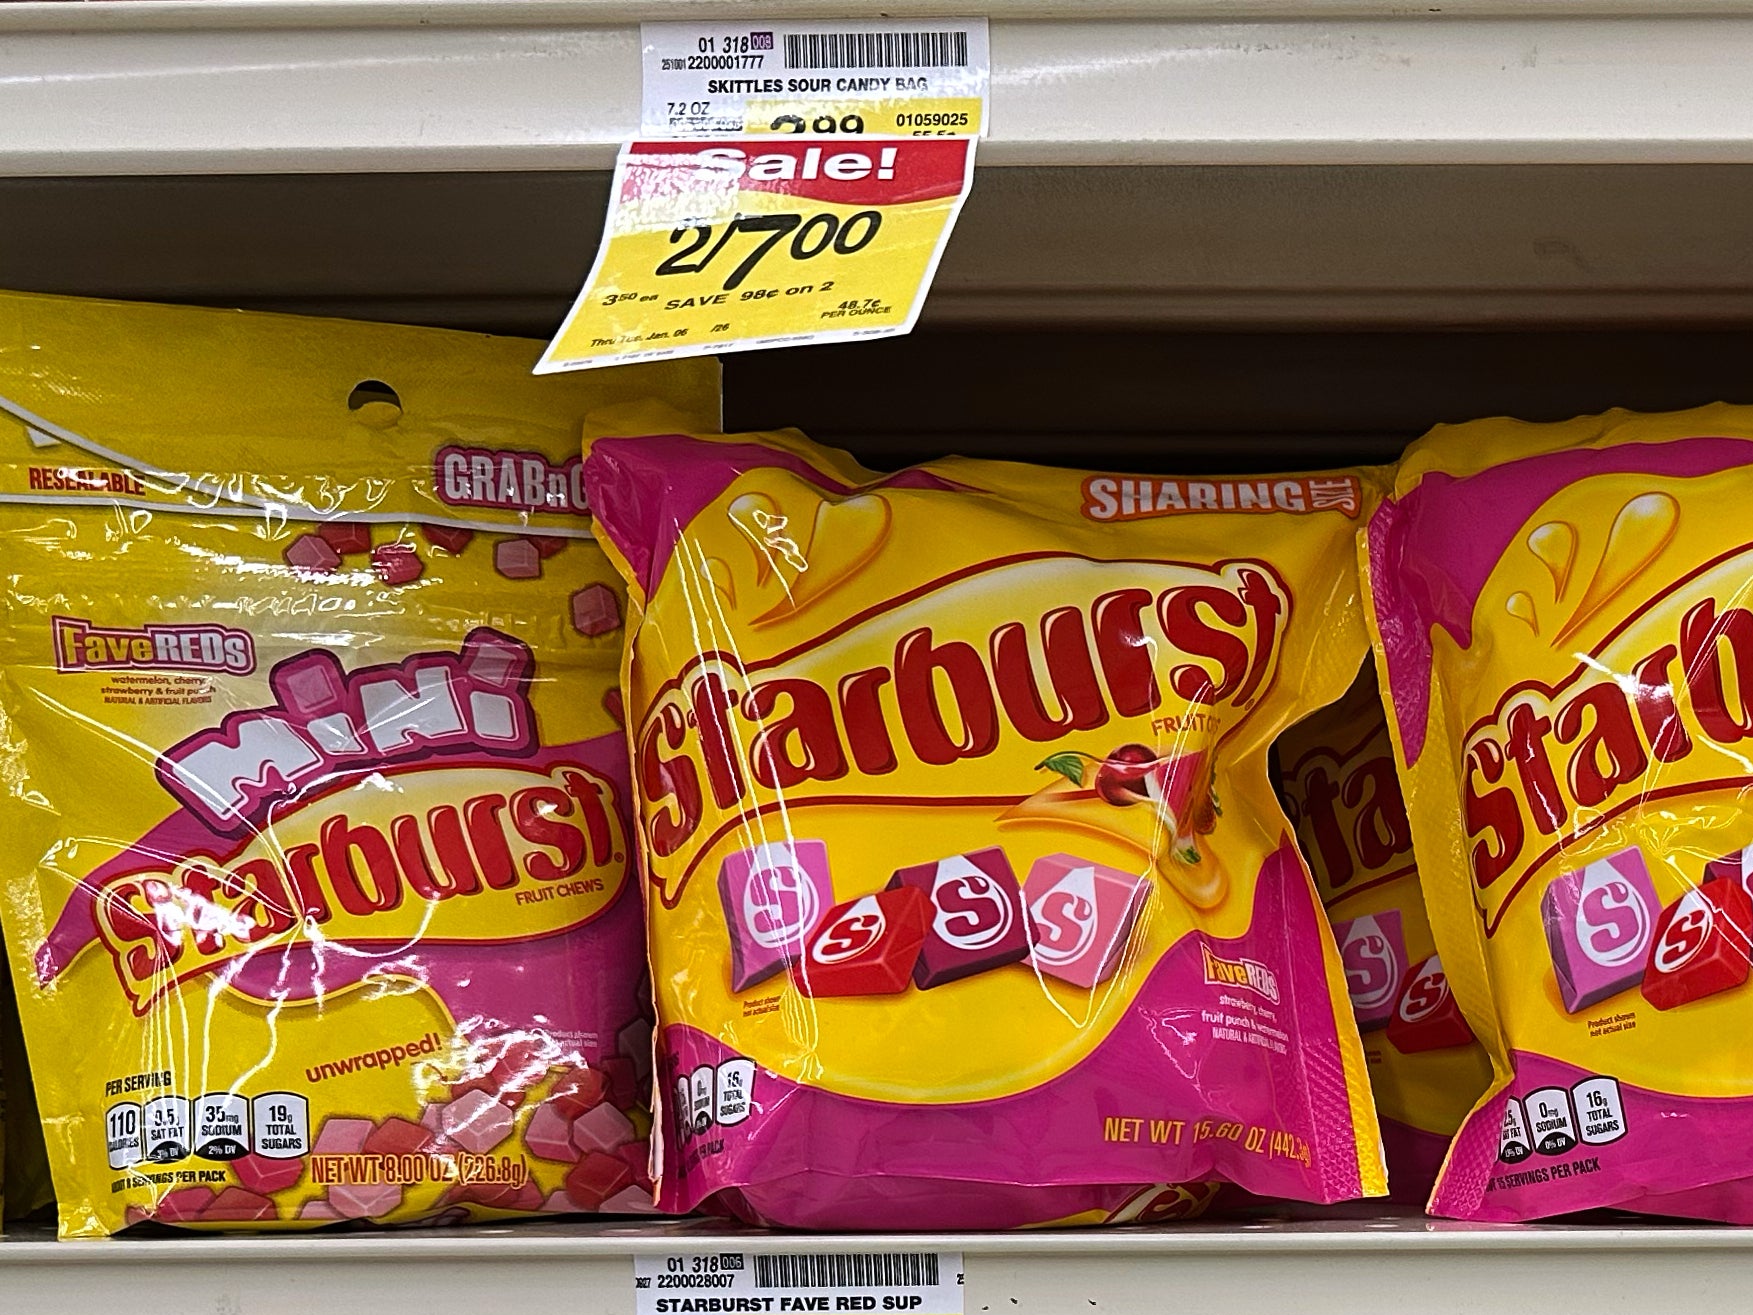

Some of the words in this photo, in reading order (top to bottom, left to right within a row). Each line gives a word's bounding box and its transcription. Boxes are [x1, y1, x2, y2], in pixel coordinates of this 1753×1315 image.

[688, 55, 764, 70] 2200001777
[708, 79, 783, 93] SKITTLES
[788, 79, 831, 92] SOUR
[836, 78, 889, 92] CANDY
[895, 77, 928, 91] BAG
[667, 103, 688, 115] 7.2
[691, 102, 710, 115] OZ
[896, 113, 968, 127] 01059025
[695, 146, 898, 181] Sale!
[664, 294, 727, 311] SAVE
[740, 288, 779, 302] 98¢
[786, 285, 813, 296] on
[819, 281, 835, 293] 2
[28, 467, 146, 496] RESEALABLE
[1088, 476, 1306, 521] SHARING
[60, 625, 250, 669] FaveREDs
[638, 566, 1282, 838] Starburst
[104, 772, 617, 978] Starburst
[515, 885, 560, 907] FRUIT
[561, 877, 605, 901] CHEWS
[306, 1031, 443, 1084] unwrapped!
[261, 1137, 302, 1151] SUGARS
[266, 1123, 298, 1136] TOTAL
[1104, 1116, 1143, 1142] NET
[1150, 1119, 1185, 1145] WT
[311, 1155, 343, 1185] NET
[345, 1155, 382, 1185] WT
[384, 1156, 425, 1183] 8.00
[458, 1154, 528, 1188] (226.8g)
[1505, 1163, 1548, 1188] SERVINGS
[1550, 1161, 1571, 1180] PER
[1573, 1159, 1601, 1176] PACK
[658, 1275, 735, 1288] 2200028007
[656, 1298, 772, 1312] STARBURST
[781, 1298, 829, 1311] FAVE
[836, 1297, 875, 1310] RED
[882, 1297, 922, 1310] SUP
